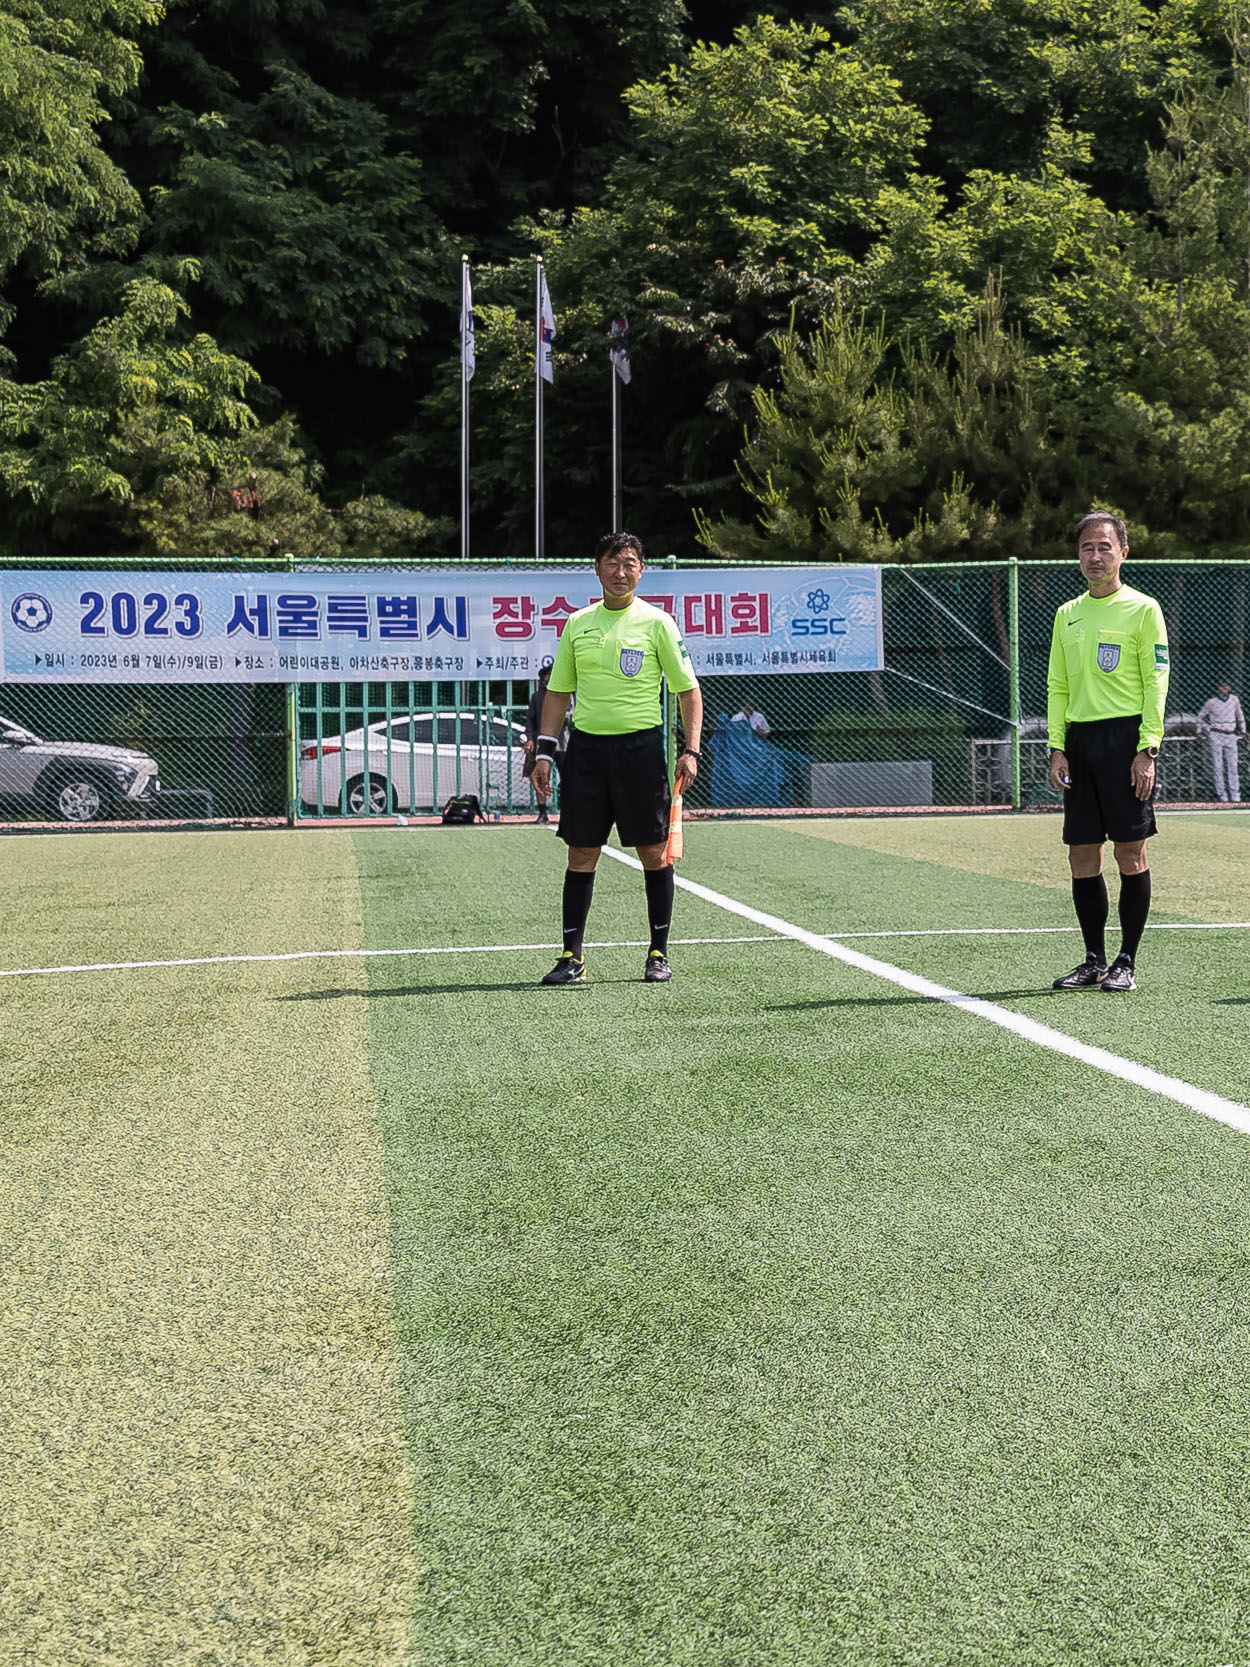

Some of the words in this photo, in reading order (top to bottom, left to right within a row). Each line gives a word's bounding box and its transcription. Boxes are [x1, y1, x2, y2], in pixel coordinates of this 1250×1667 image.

[80, 591, 202, 637] 2023
[227, 593, 469, 640] 서울특별시
[493, 592, 771, 639] 장수대회
[791, 617, 847, 636] SSC
[44, 653, 65, 668] 일시
[80, 653, 118, 668] 2023년
[123, 654, 140, 668] 6월
[244, 656, 265, 670] 장소
[485, 656, 529, 671] 주최/주관
